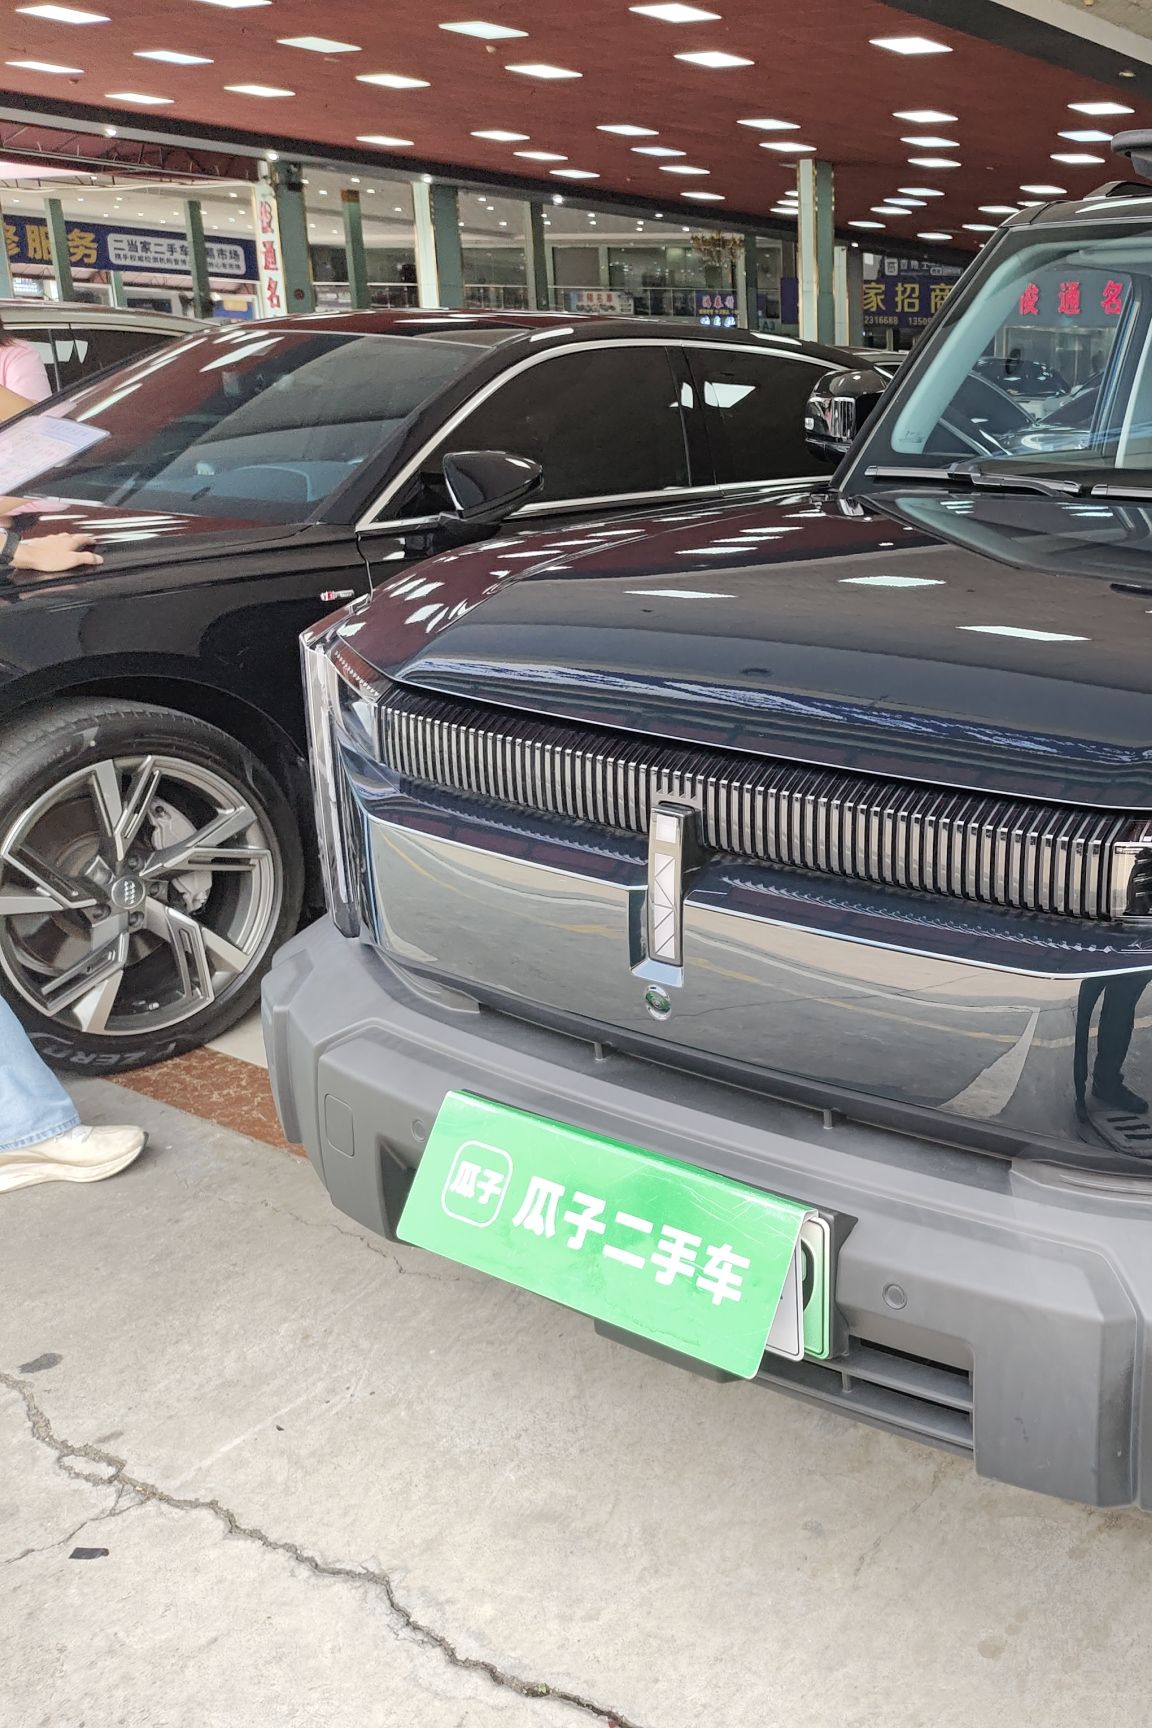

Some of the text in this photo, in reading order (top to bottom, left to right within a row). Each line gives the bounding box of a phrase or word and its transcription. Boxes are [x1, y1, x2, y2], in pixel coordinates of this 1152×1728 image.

[449, 1160, 505, 1205] 瓜子
[512, 1175, 751, 1305] 瓜子二手车
